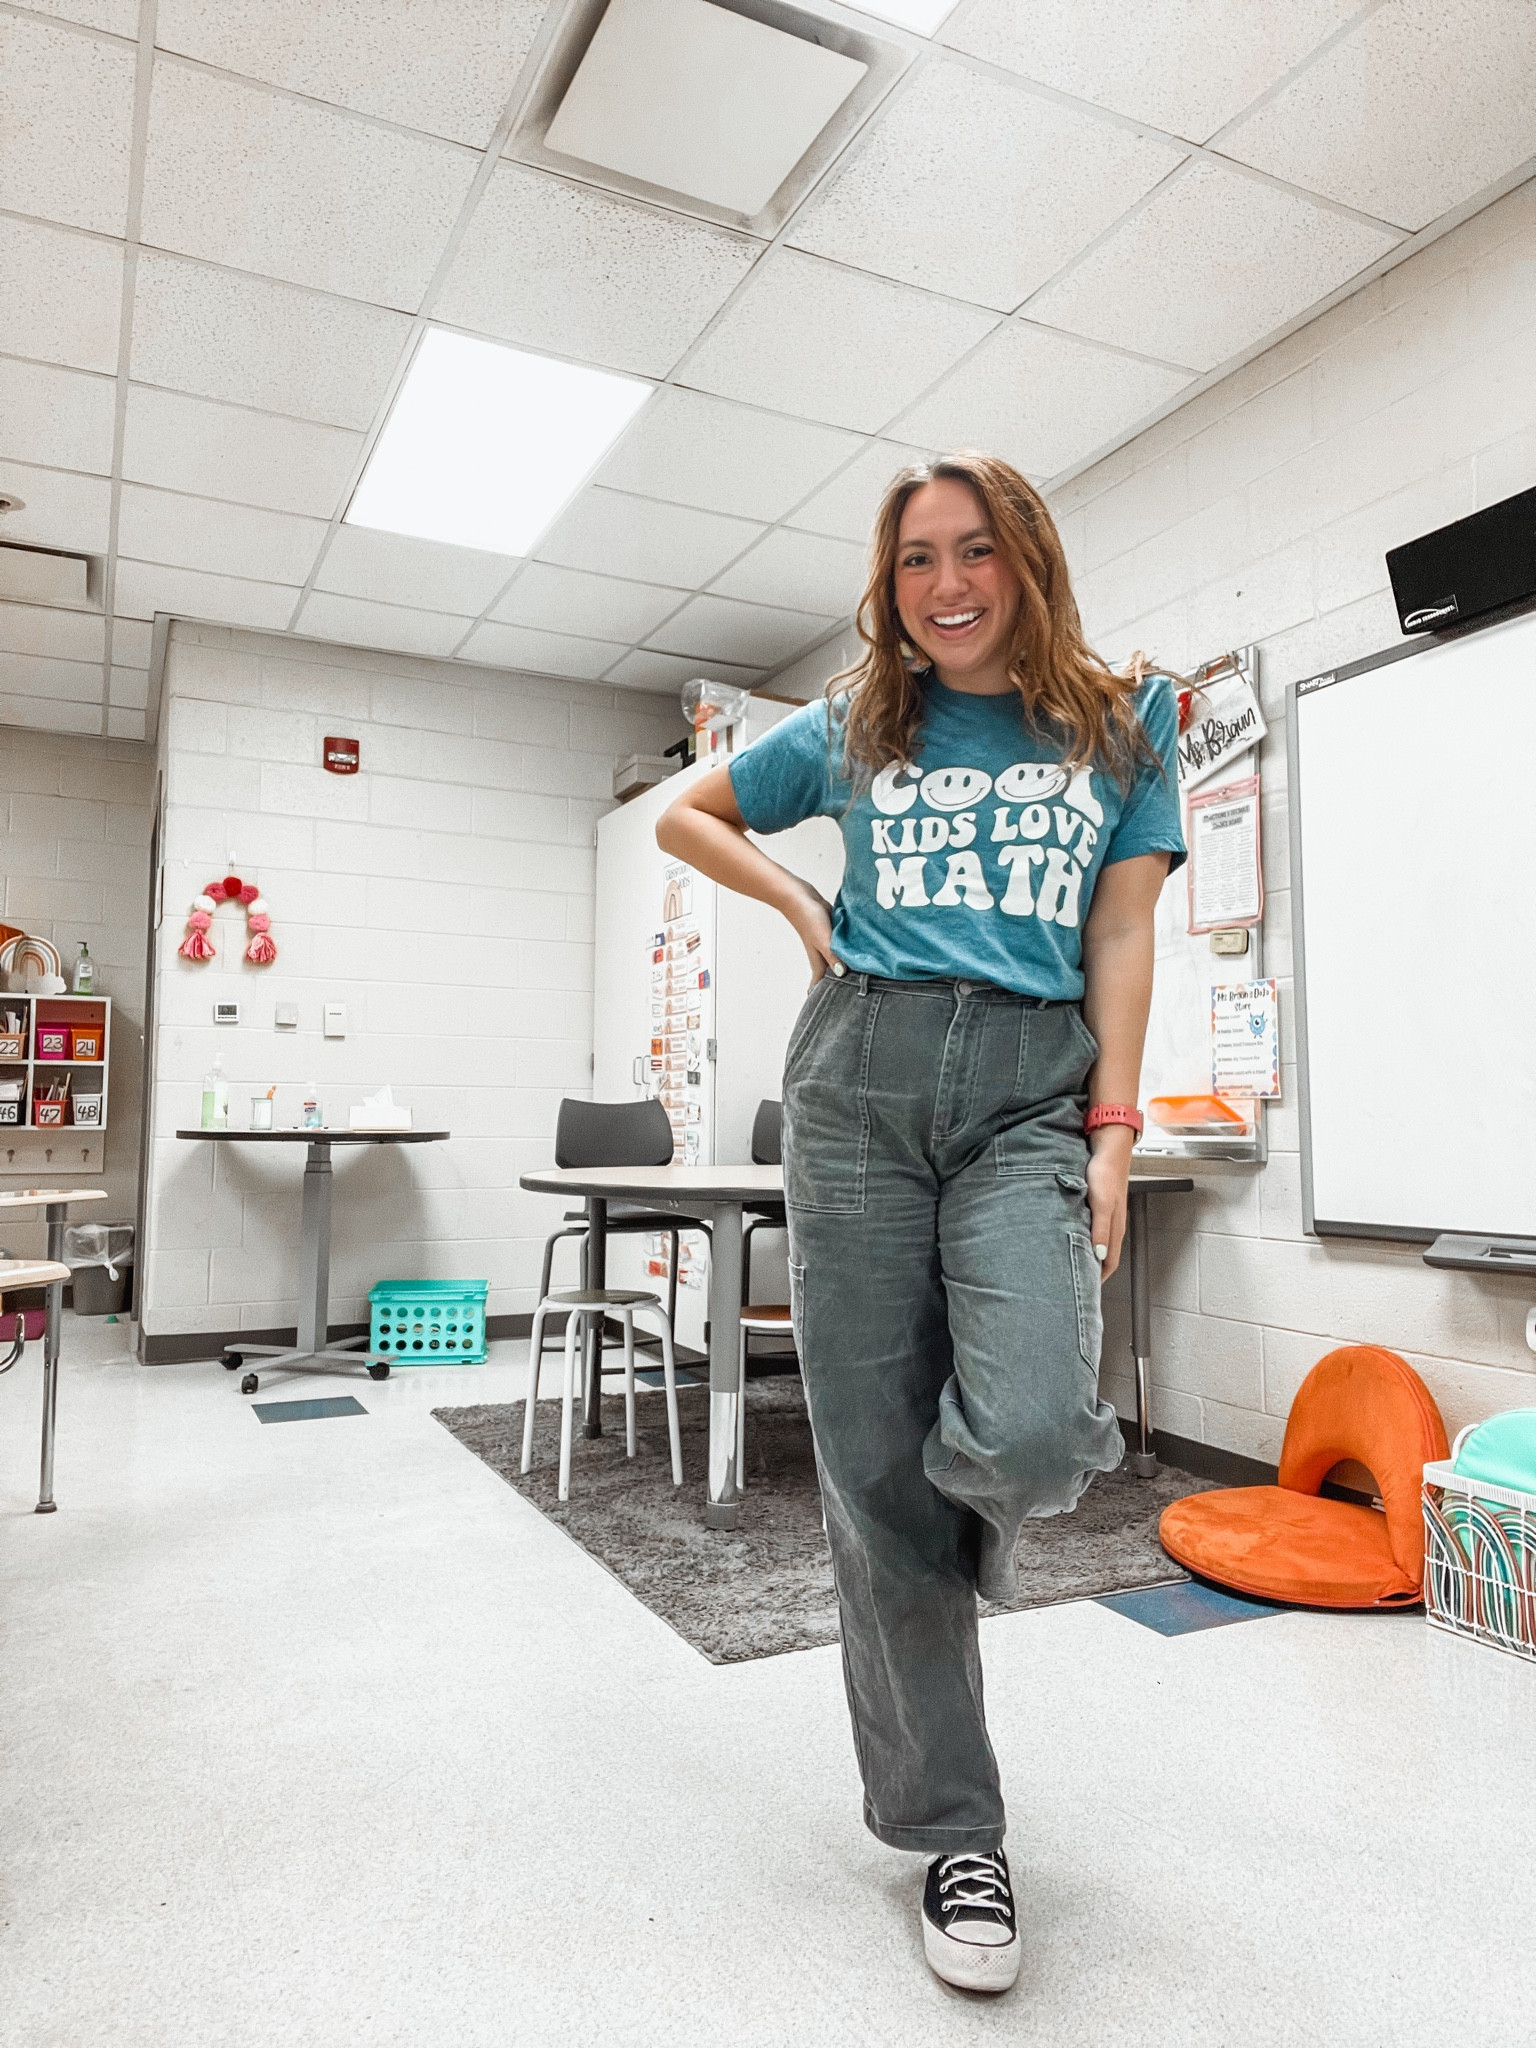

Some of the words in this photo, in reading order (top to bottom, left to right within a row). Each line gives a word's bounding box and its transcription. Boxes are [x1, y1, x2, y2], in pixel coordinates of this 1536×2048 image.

[871, 759, 1104, 828] COOL
[870, 812, 977, 854] KIDS
[990, 803, 1098, 868] LOVE
[874, 843, 1083, 928] MATH
[0, 1041, 19, 1055] 22
[43, 1037, 63, 1050] 23
[77, 1041, 94, 1054] 24
[40, 1108, 60, 1122] 47
[77, 1105, 97, 1118] 48
